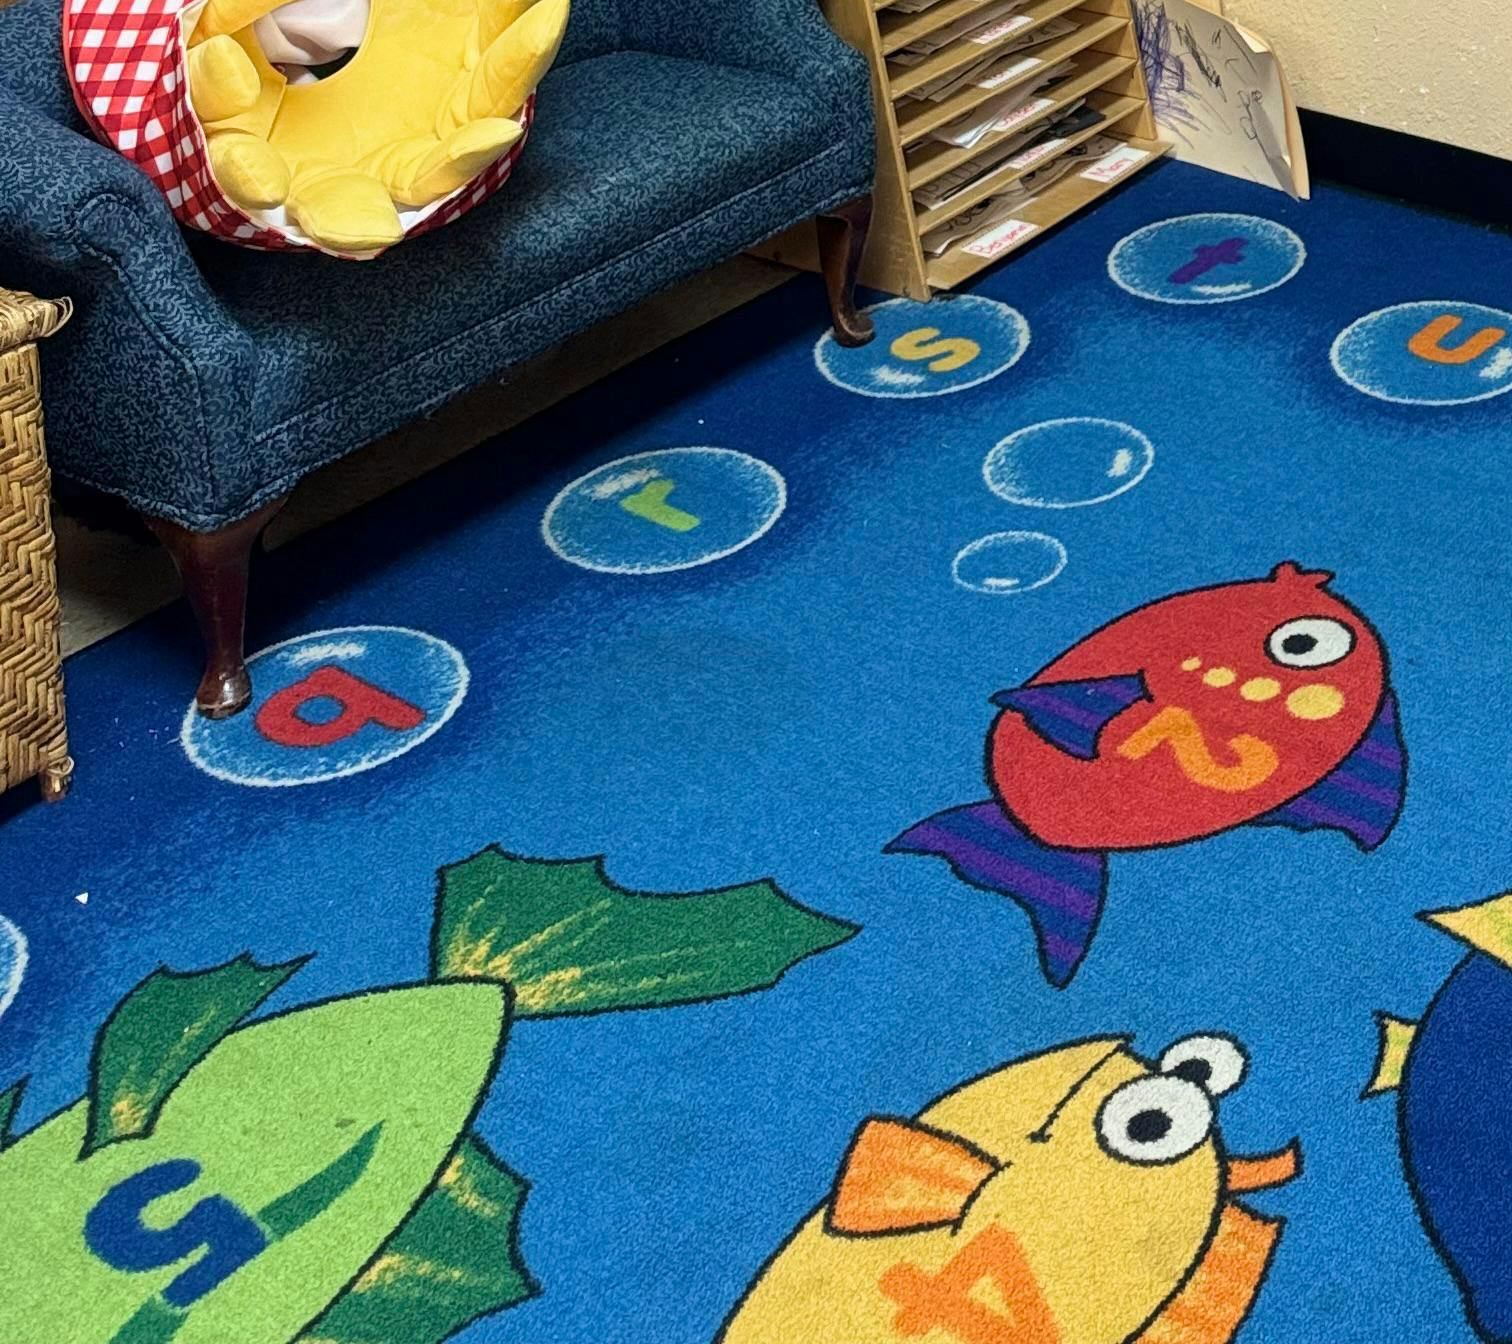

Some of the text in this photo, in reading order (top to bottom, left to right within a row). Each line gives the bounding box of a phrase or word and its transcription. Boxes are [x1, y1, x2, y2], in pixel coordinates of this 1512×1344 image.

[1167, 235, 1246, 285] t
[890, 326, 981, 373] s
[1407, 313, 1507, 365] u
[619, 479, 701, 533] r
[1117, 706, 1280, 793] 2
[84, 1159, 267, 1309] 5
